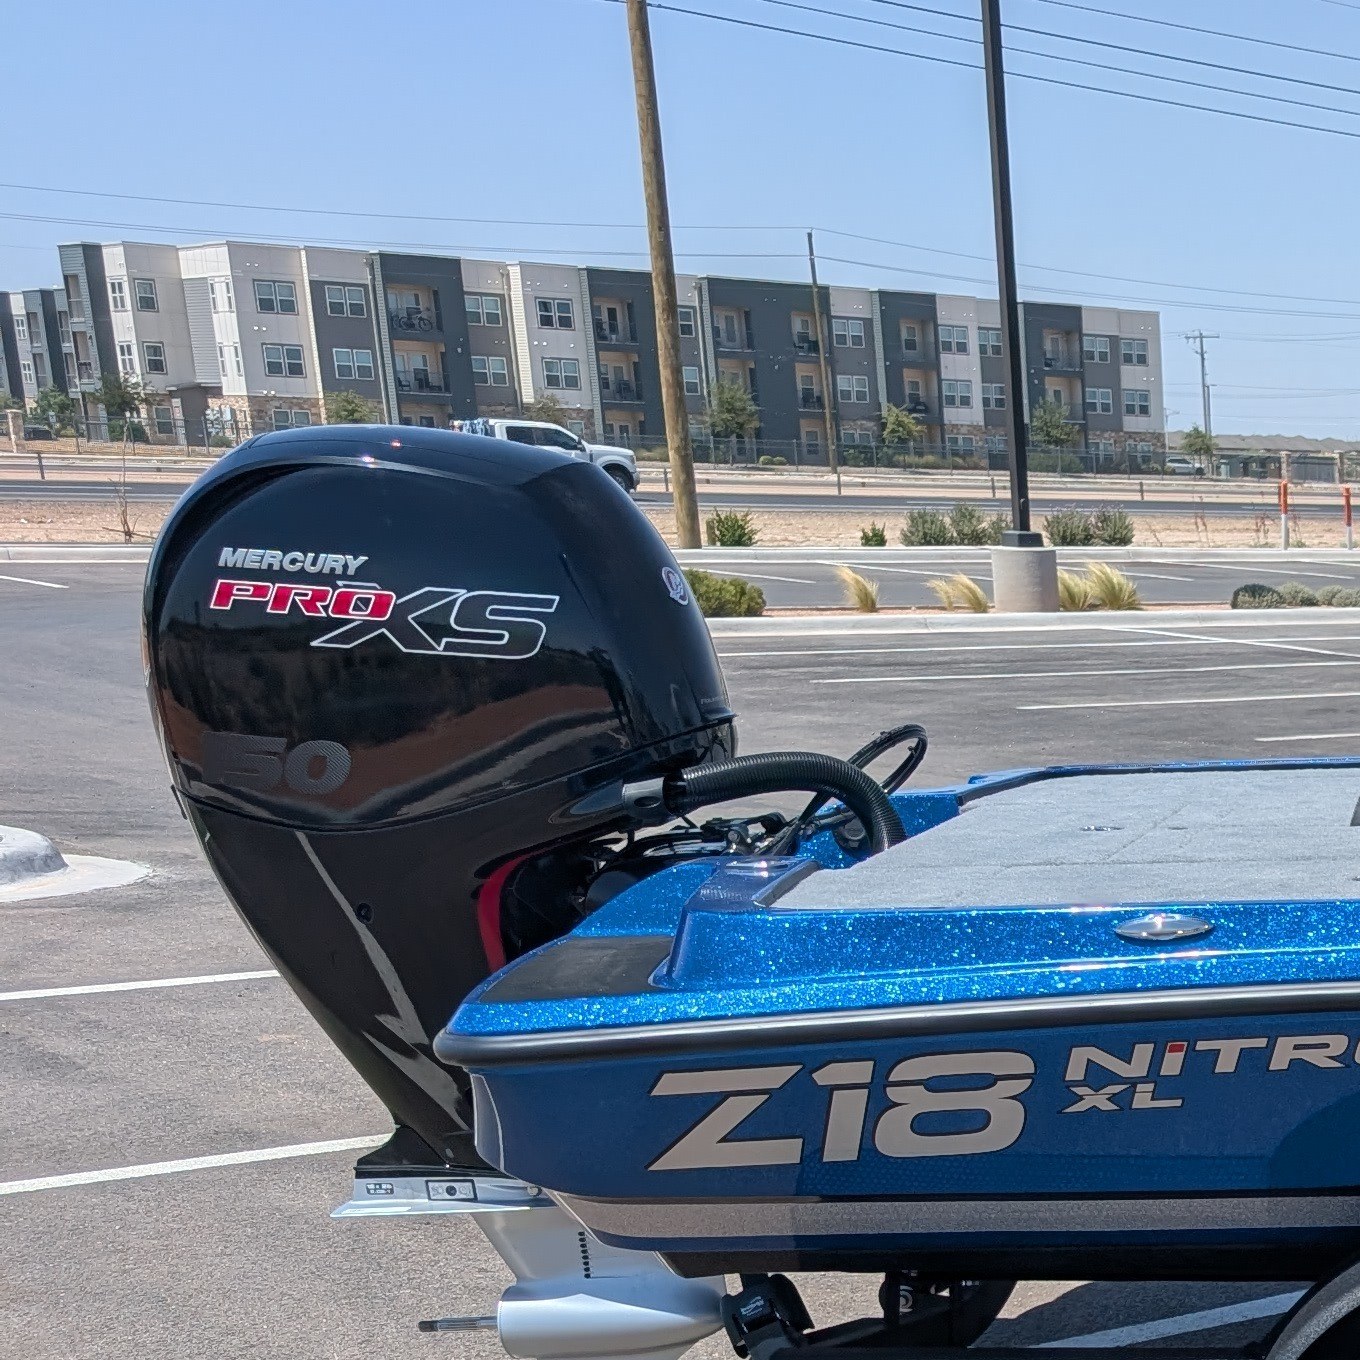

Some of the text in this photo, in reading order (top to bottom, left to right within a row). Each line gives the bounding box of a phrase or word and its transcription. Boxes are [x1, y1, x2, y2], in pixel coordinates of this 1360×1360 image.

[217, 547, 368, 576] MERCURY
[645, 1050, 1037, 1171] Z18
[1060, 1083, 1183, 1114] XL
